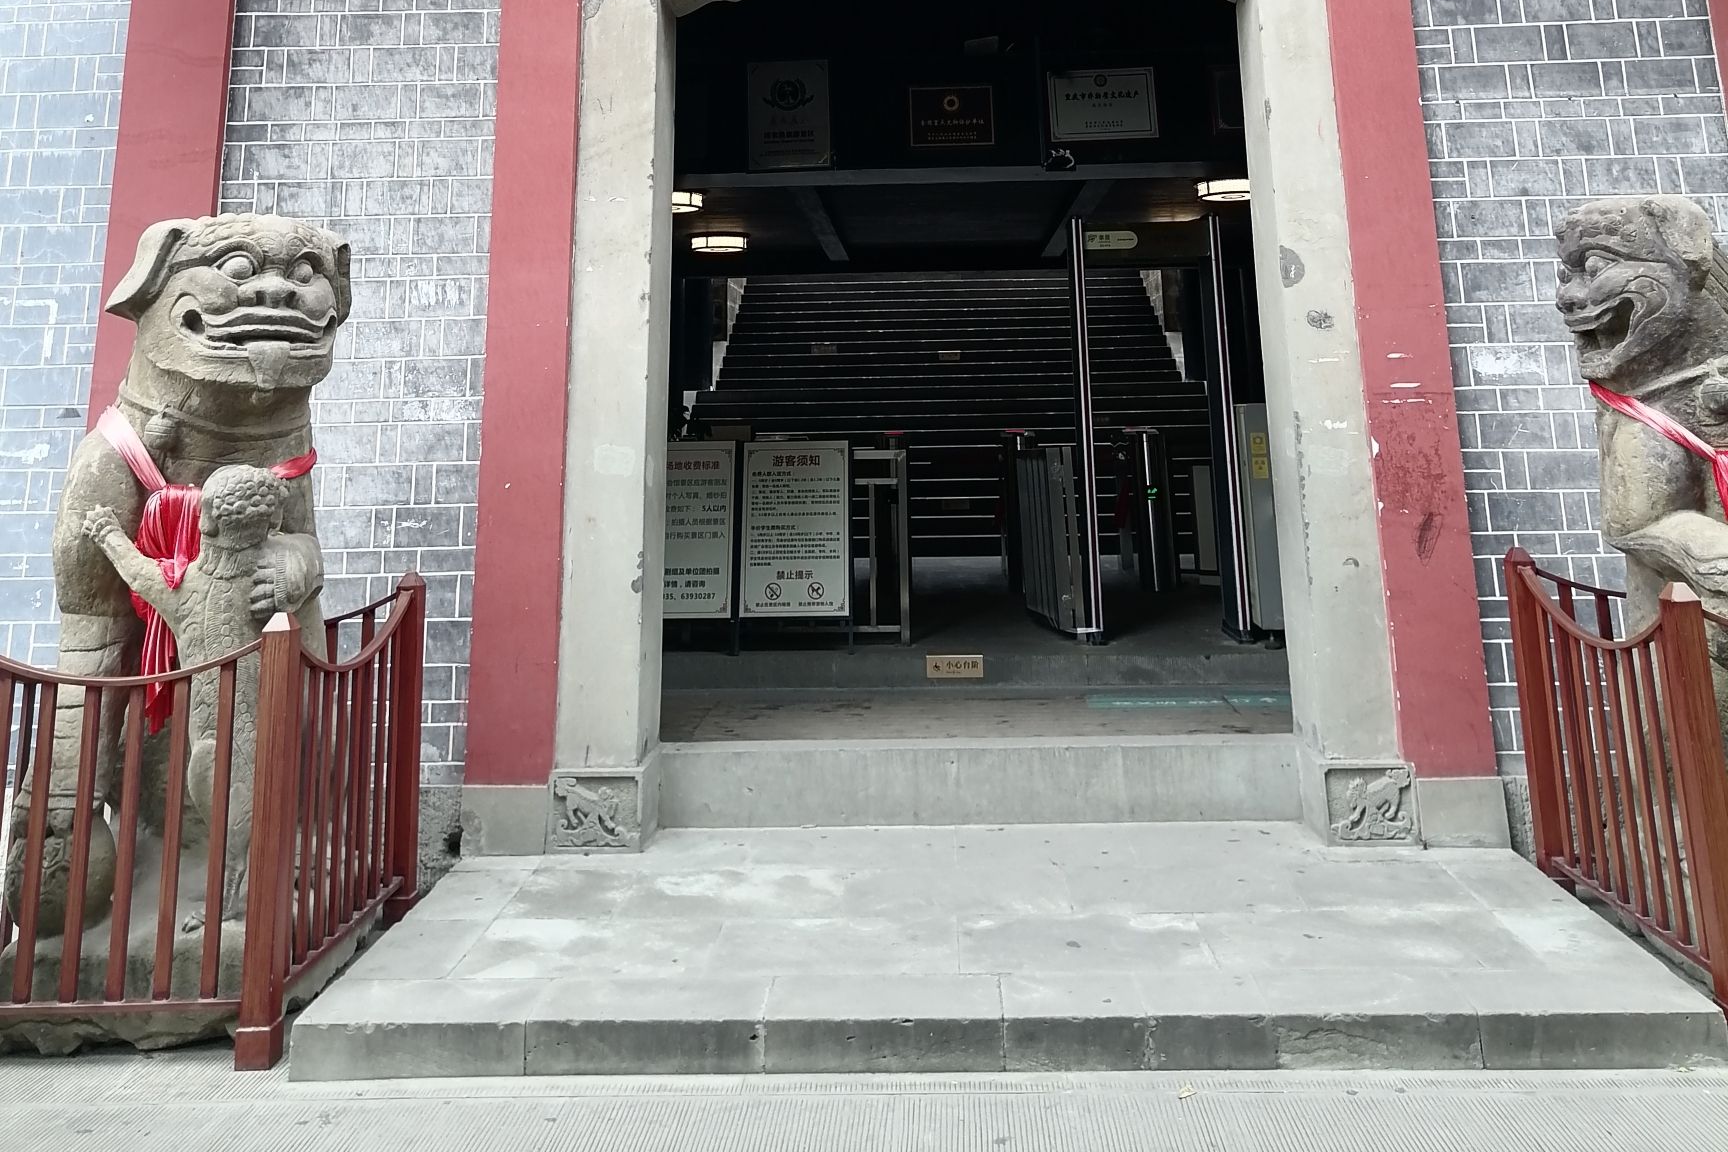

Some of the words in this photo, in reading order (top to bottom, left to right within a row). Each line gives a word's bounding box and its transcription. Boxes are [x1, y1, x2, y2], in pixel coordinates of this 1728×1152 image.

[772, 454, 821, 467] 游客须知
[776, 570, 814, 581] 禁止提示
[946, 660, 979, 670] 小心台阶
